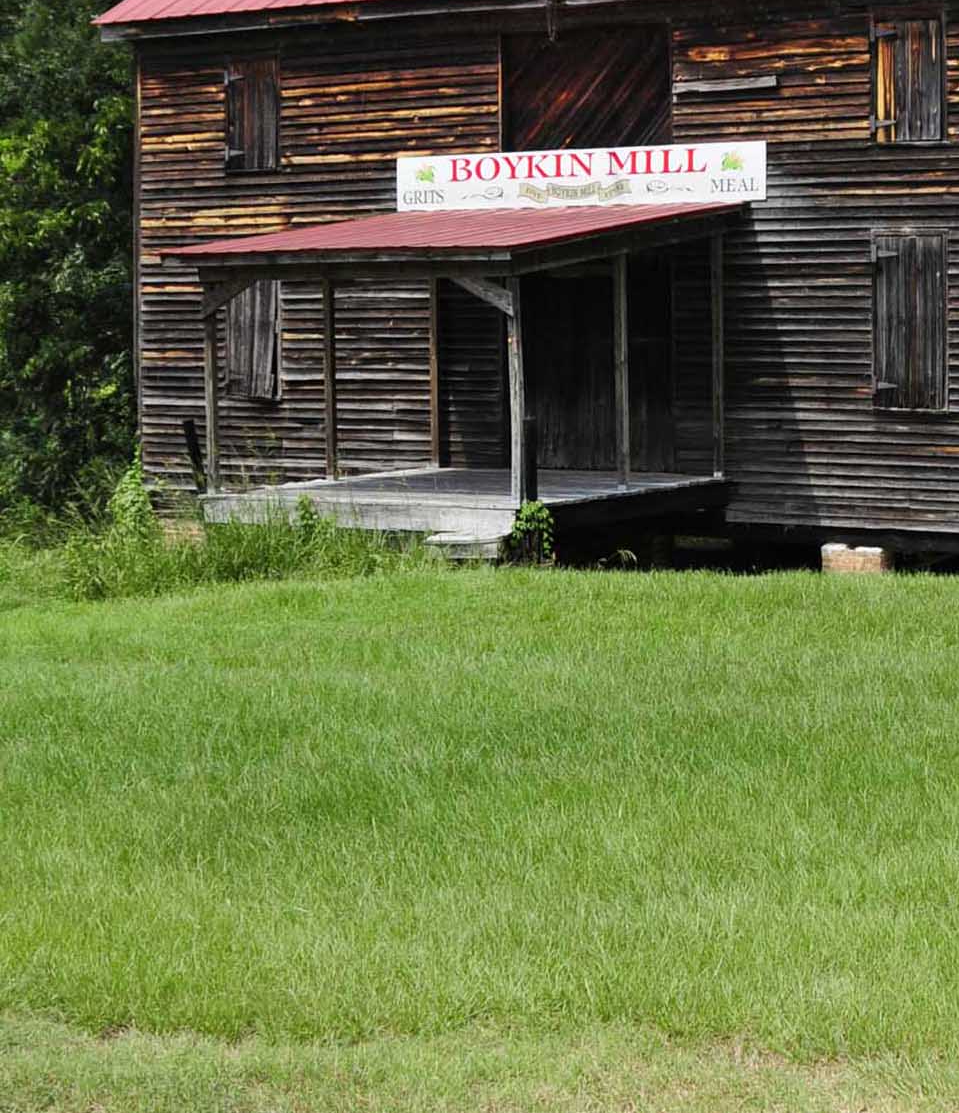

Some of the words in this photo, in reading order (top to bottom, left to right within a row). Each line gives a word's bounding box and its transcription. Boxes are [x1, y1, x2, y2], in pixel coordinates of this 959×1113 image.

[449, 152, 593, 183] BOYKIN
[608, 148, 707, 176] MILL
[710, 178, 760, 193] MEAL
[403, 189, 445, 206] GRITS
